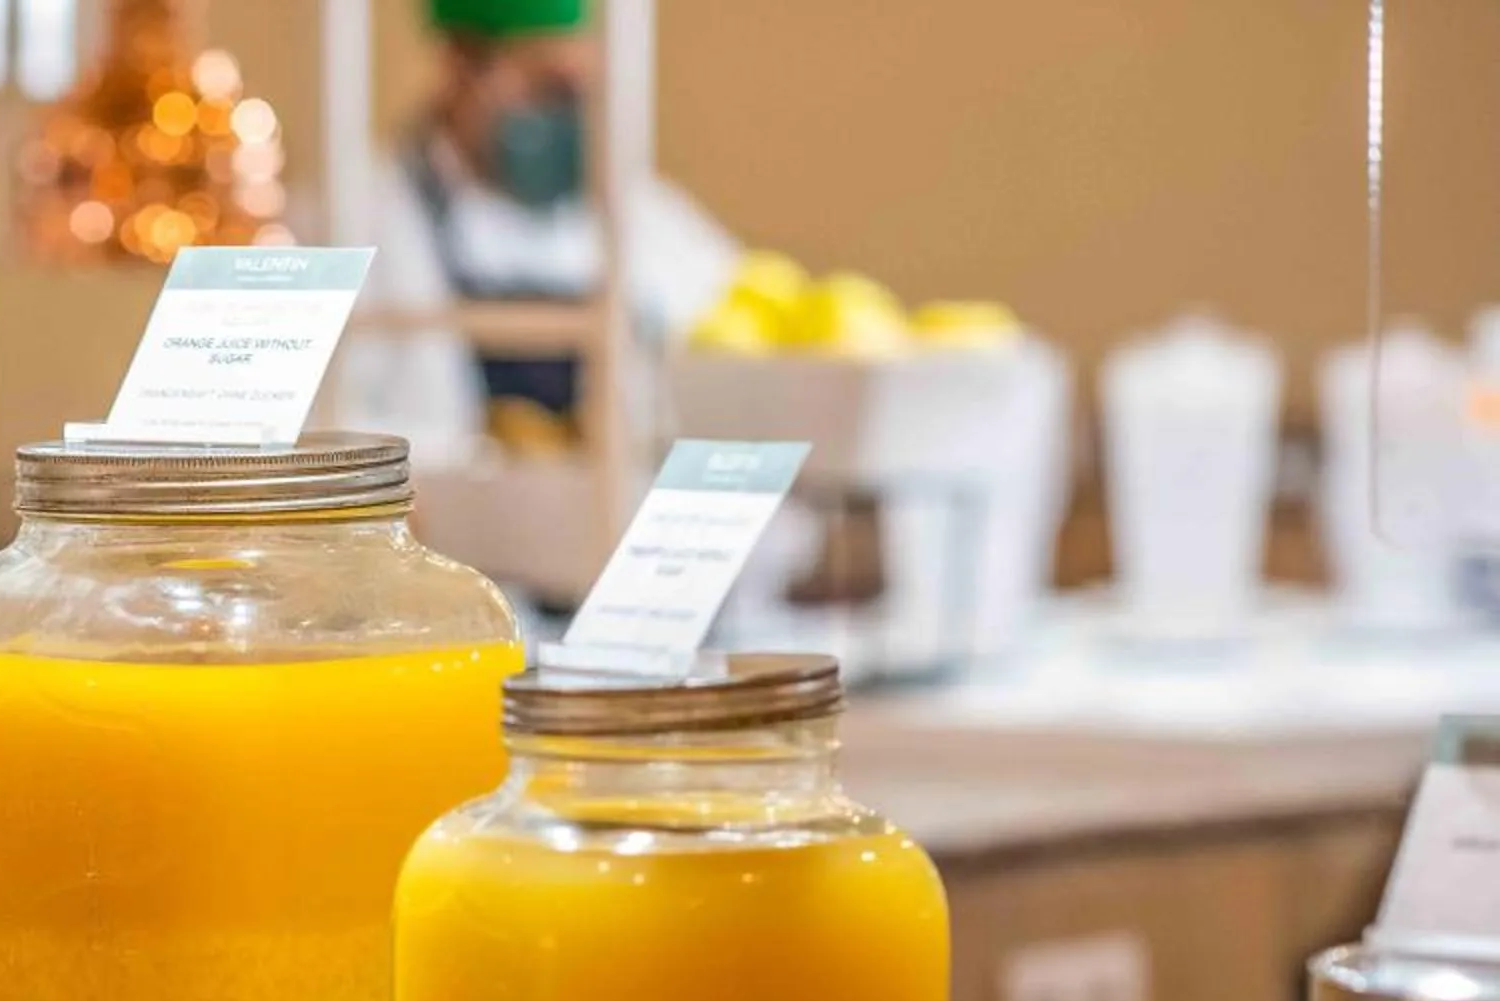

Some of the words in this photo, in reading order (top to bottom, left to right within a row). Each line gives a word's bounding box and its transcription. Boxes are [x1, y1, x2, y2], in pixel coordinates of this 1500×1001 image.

[234, 256, 309, 272] VALENTIN
[162, 337, 215, 350] ORANGE
[216, 338, 252, 350] JUICE
[254, 338, 314, 351] WITHOUT
[207, 353, 253, 364] SUGAR
